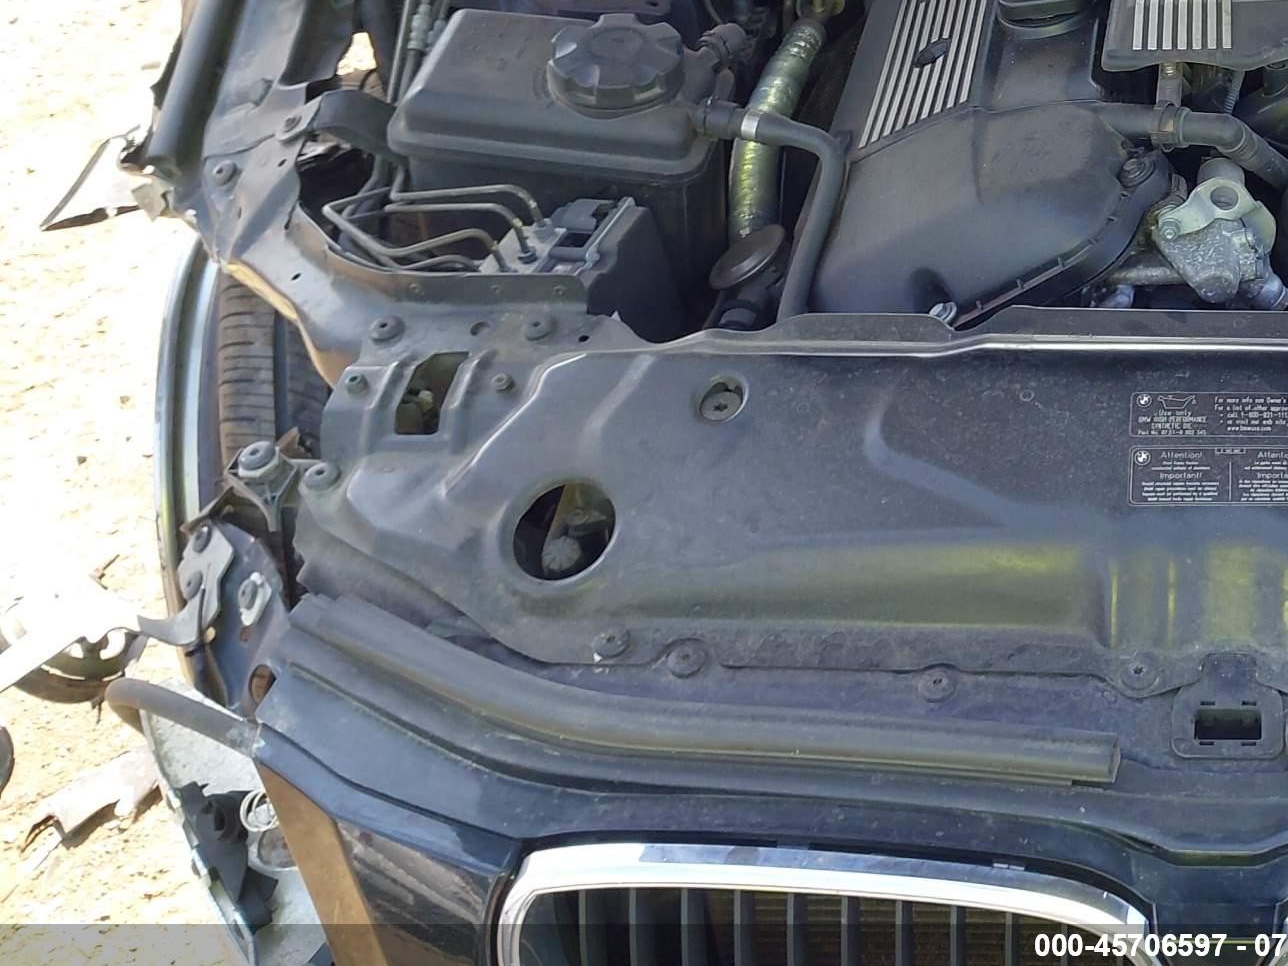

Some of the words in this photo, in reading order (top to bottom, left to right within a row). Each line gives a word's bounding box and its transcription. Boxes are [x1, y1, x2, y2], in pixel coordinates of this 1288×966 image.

[1175, 409, 1192, 418] only
[1160, 451, 1203, 459] Attention!
[1159, 472, 1203, 480] Important!
